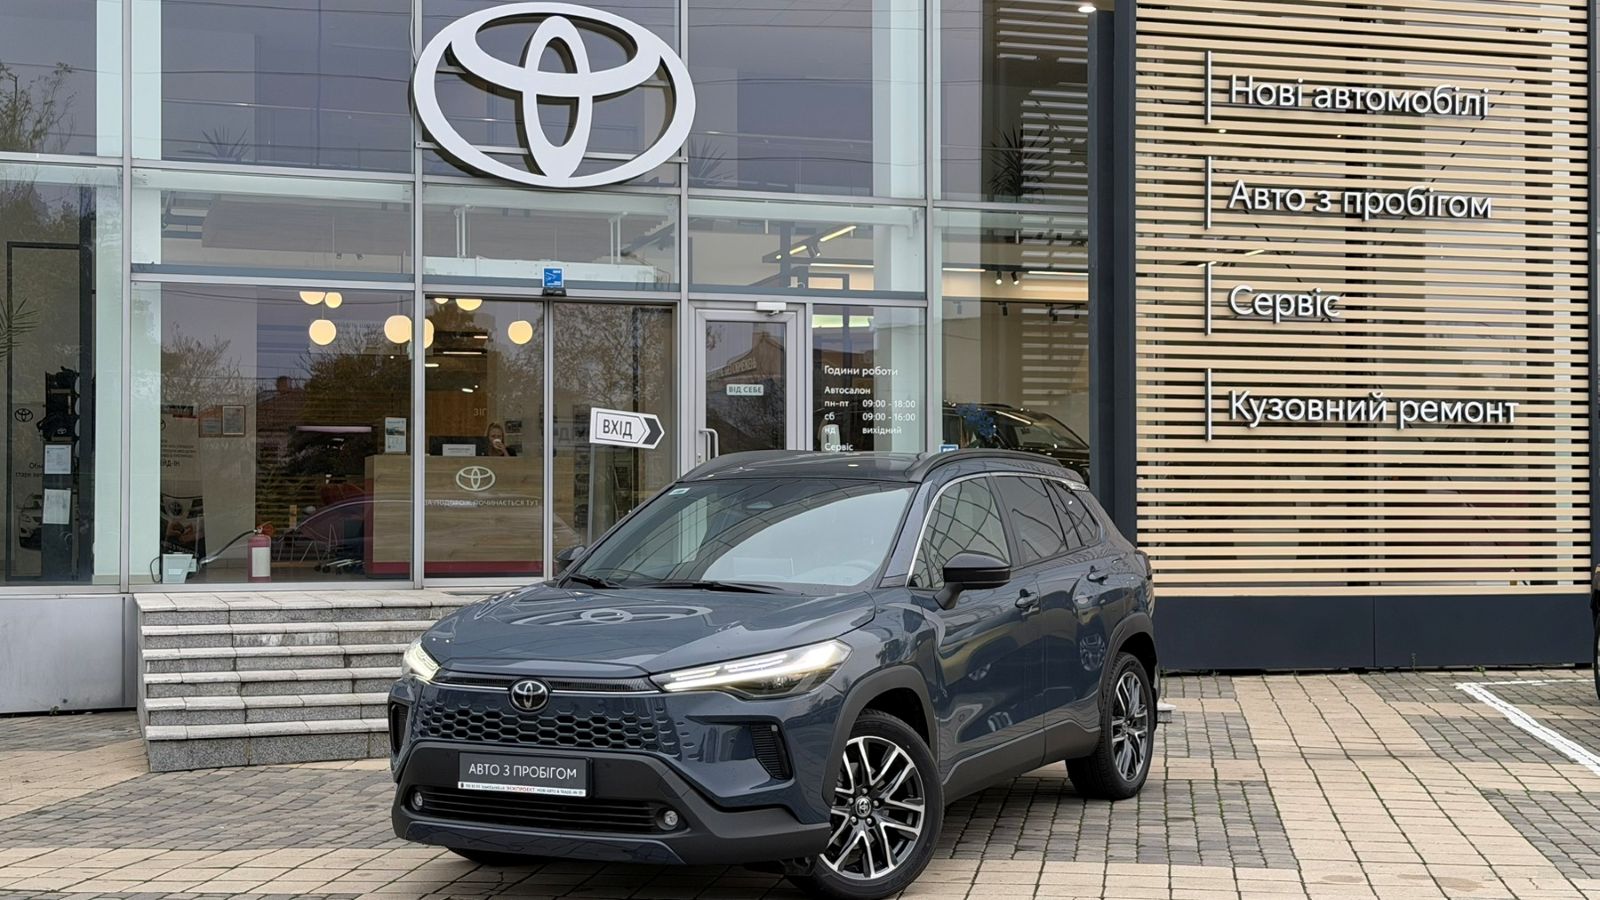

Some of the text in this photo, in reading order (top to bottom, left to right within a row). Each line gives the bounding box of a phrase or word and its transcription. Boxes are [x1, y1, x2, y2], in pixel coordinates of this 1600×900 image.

[1230, 74, 1489, 116] Нові автомобілі
[1228, 180, 1492, 221] Авто з пробігом
[1229, 285, 1341, 323] Сервіс
[824, 365, 899, 377] Години роботи
[728, 386, 742, 394] ВІД
[824, 386, 871, 394] Автосалон
[862, 399, 886, 408] 09:00
[894, 400, 916, 408] 18:00
[1230, 390, 1520, 429] Кузовний ремонт
[824, 412, 835, 421] сб
[862, 412, 886, 421] 09:00
[894, 413, 916, 421] 16:00
[602, 418, 633, 440] ВХІД
[862, 426, 902, 435] вихідний
[824, 442, 854, 451] Сервіс
[468, 763, 577, 780] АВТО З ПРОБІГОМ
